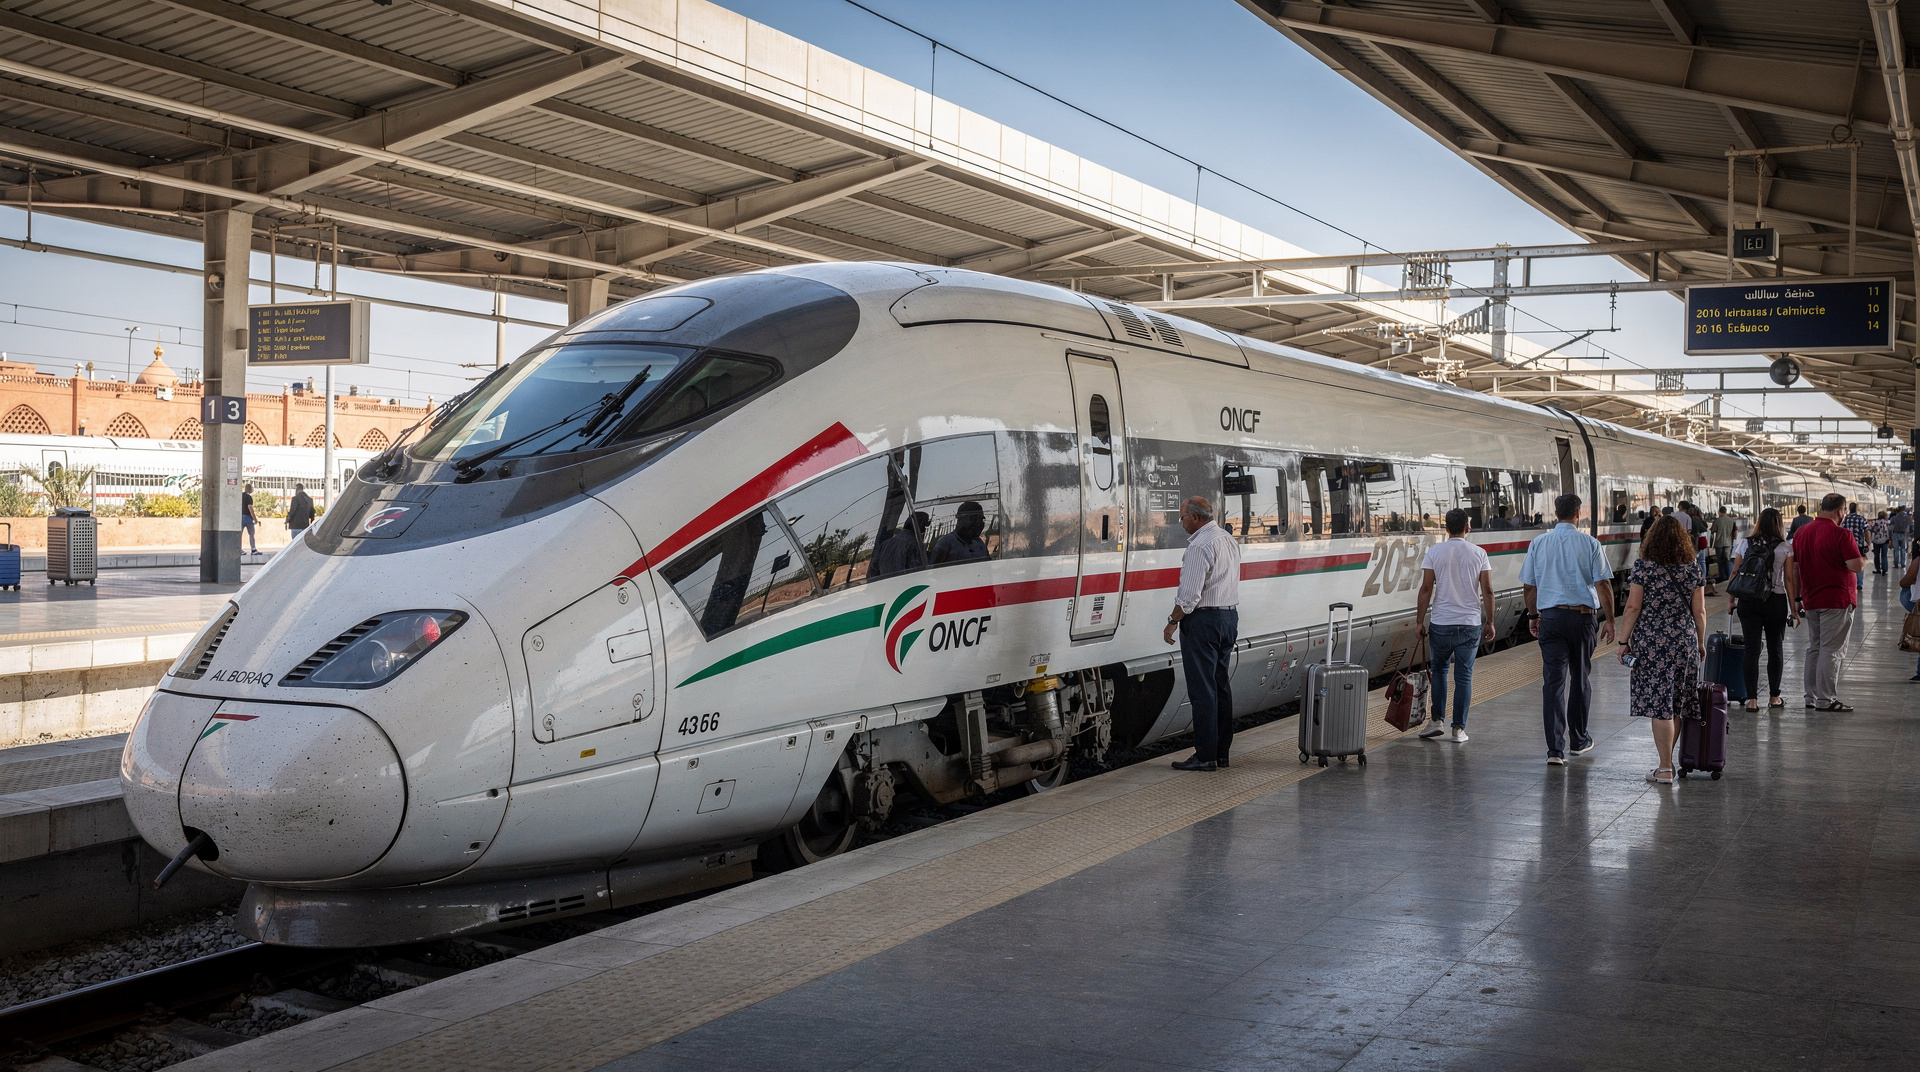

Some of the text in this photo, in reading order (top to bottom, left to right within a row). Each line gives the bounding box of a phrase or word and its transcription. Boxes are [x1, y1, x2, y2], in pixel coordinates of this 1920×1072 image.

[1868, 286, 1879, 296] 11
[1696, 308, 1720, 318] 2016
[1868, 304, 1880, 313] 10
[1868, 320, 1880, 330] 14
[1220, 406, 1261, 434] ONCF
[928, 615, 991, 653] ONCF
[209, 669, 274, 688] AL BORAQ
